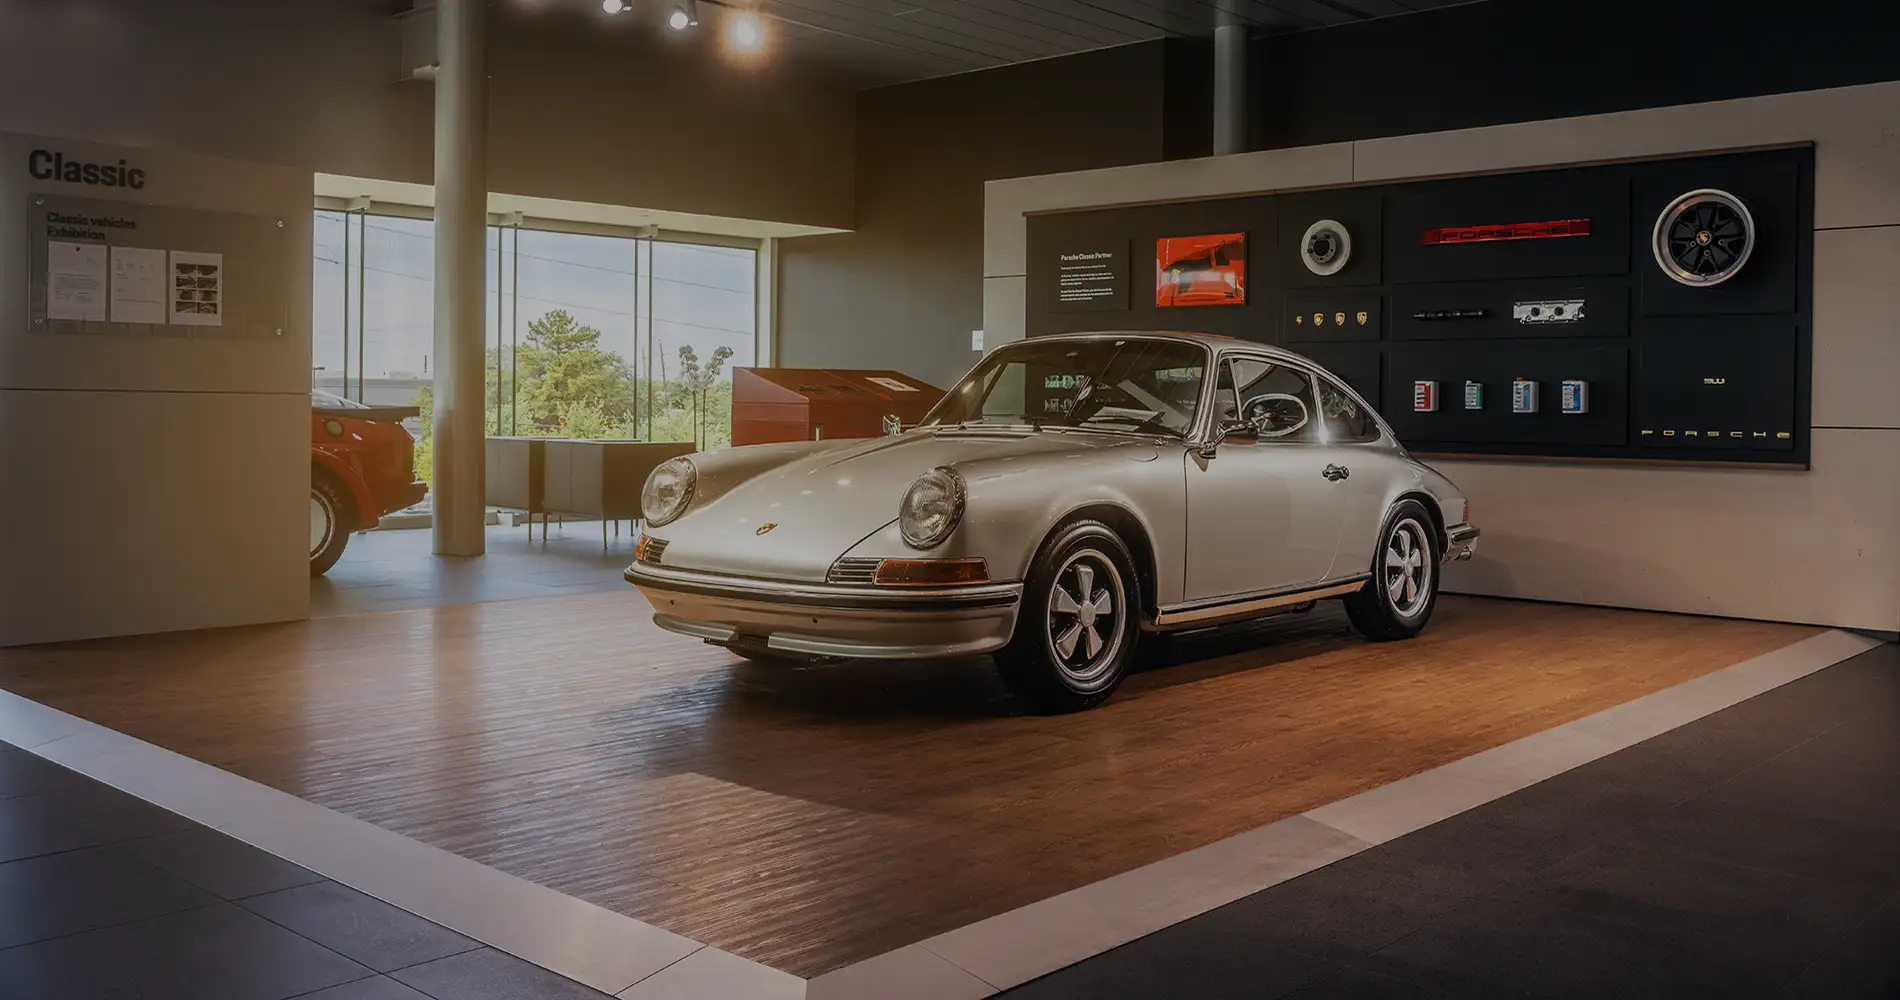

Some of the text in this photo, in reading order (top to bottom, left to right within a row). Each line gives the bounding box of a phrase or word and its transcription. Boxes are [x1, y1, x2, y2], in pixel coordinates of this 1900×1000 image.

[29, 149, 146, 189] Classic
[47, 211, 137, 229] Classic vehicles
[47, 226, 105, 240] Exhibition
[1442, 224, 1569, 241] PORSCHE
[1079, 252, 1095, 260] Classic
[1640, 429, 1791, 440] PORSCHE
